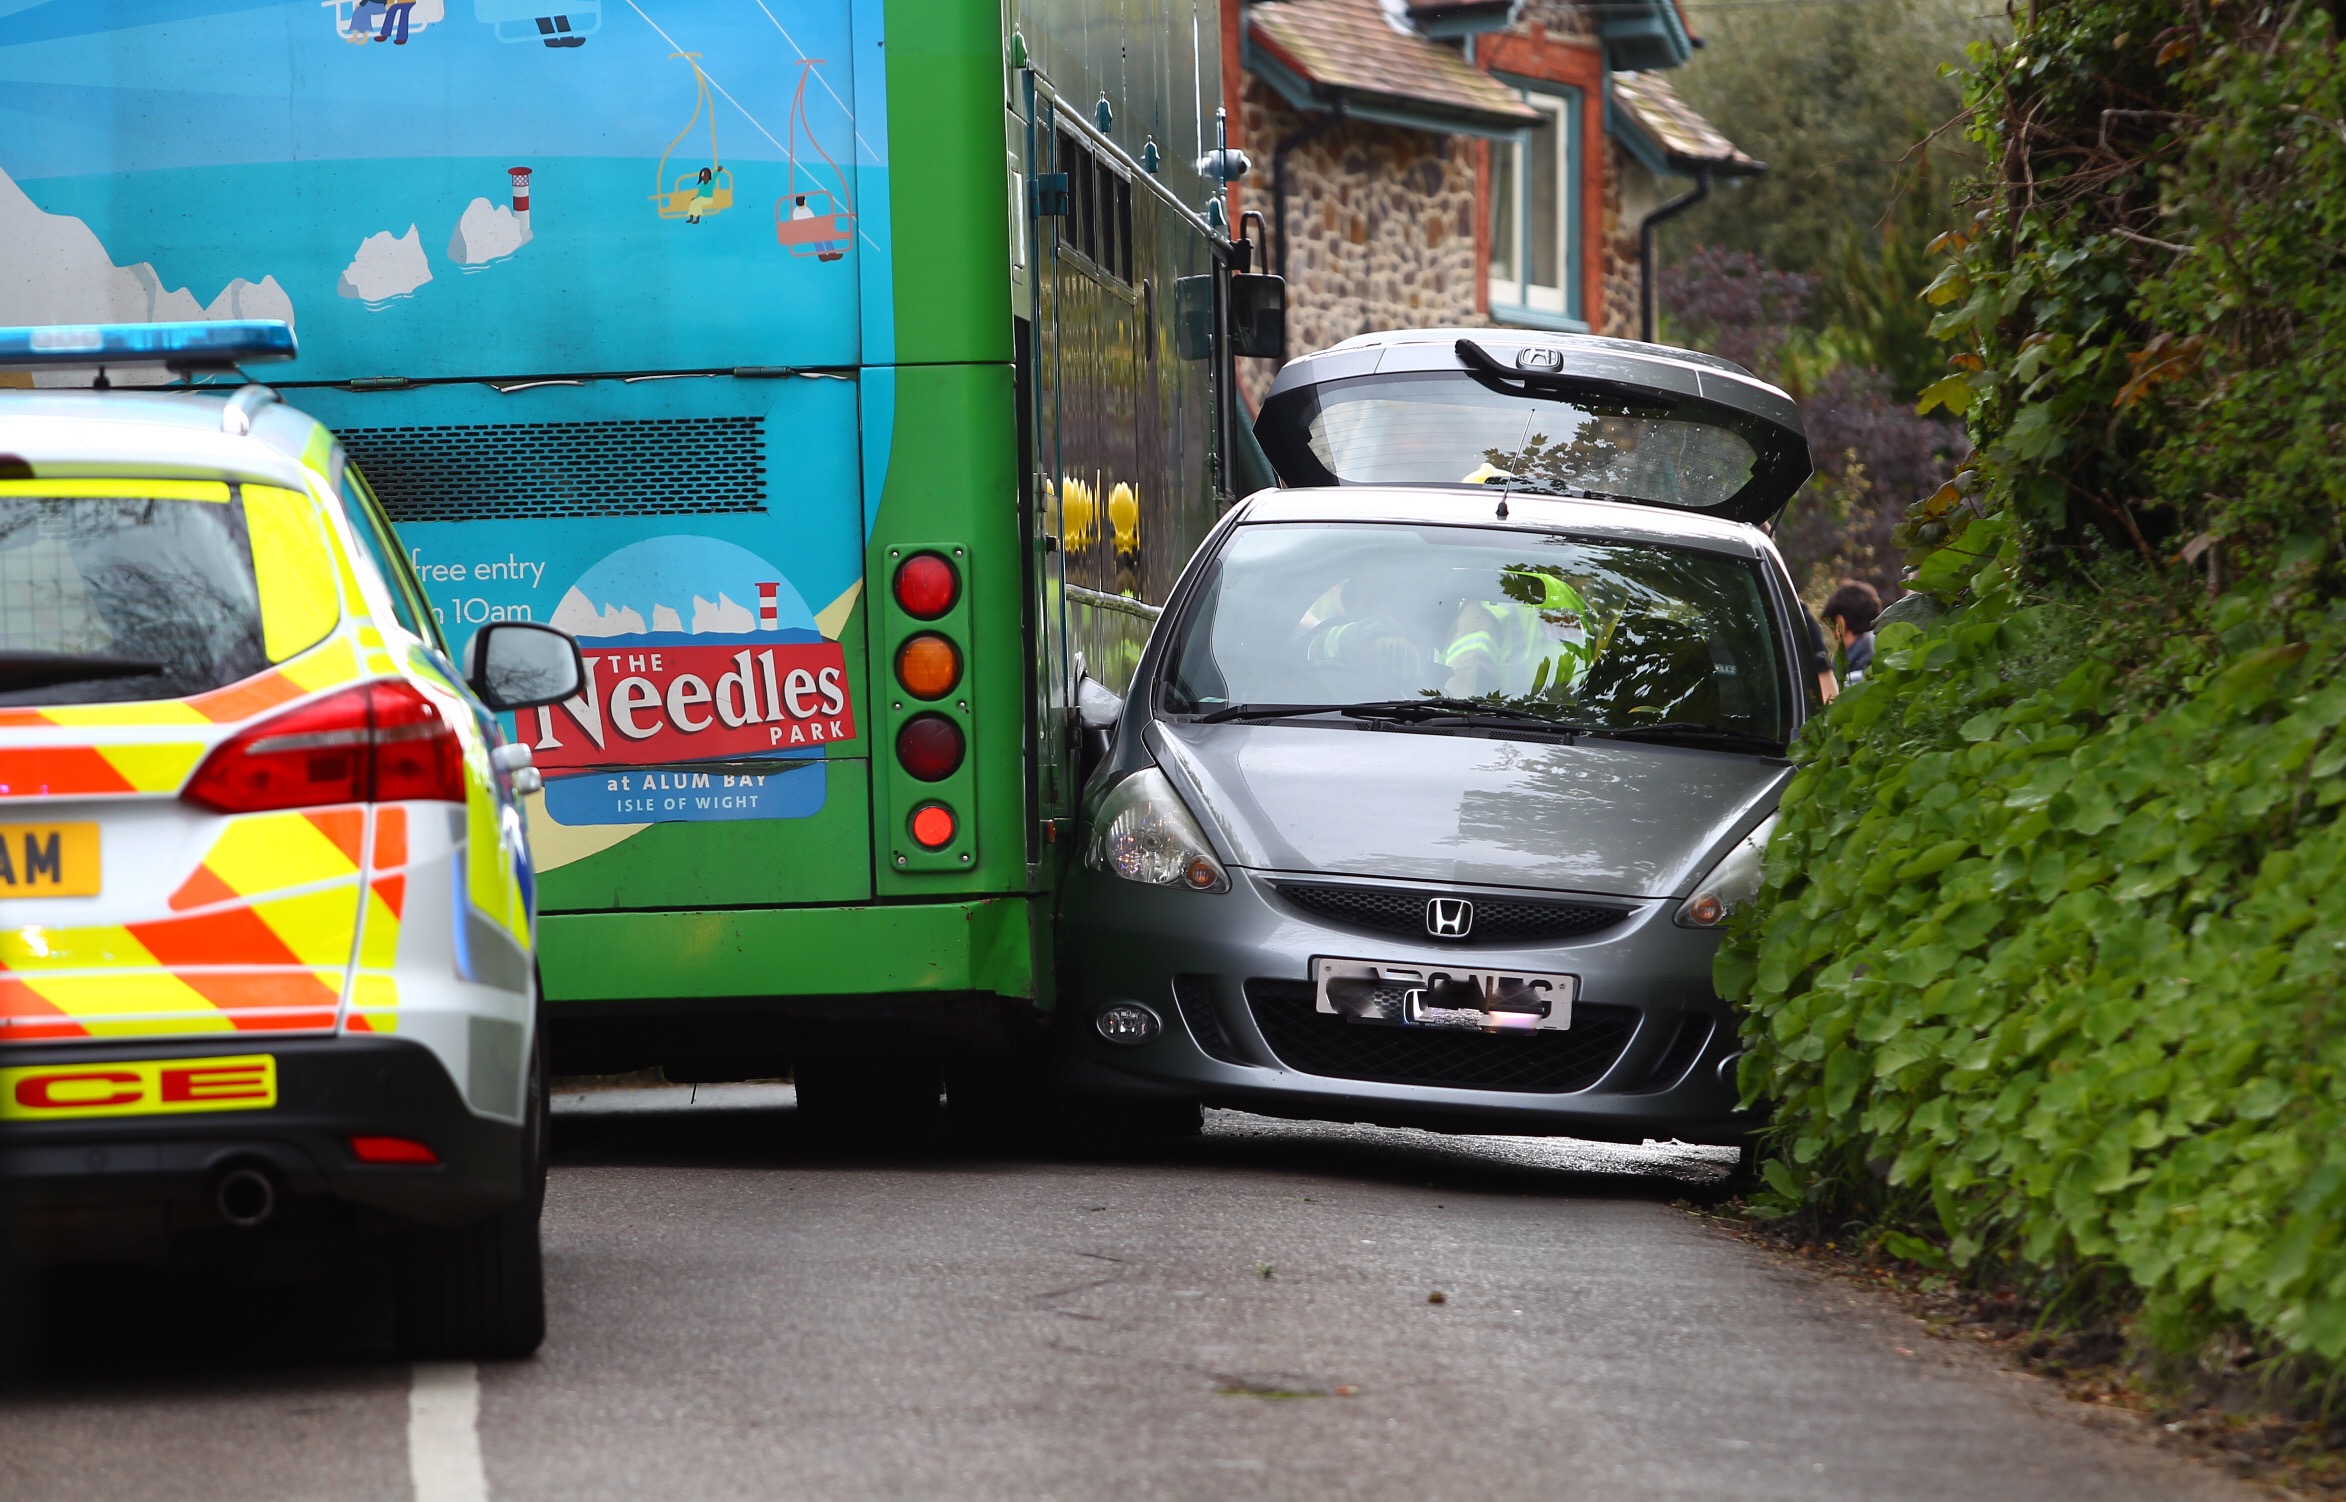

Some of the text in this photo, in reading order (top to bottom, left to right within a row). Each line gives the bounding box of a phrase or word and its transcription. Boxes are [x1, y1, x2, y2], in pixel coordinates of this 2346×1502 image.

[412, 548, 546, 589] free entry
[452, 597, 532, 625] 10am
[607, 653, 663, 674] THE
[534, 648, 844, 751] Needles
[769, 720, 845, 745] PARK
[607, 773, 767, 791] at ALUM BAY
[617, 795, 759, 813] ISLE OF WIGHT
